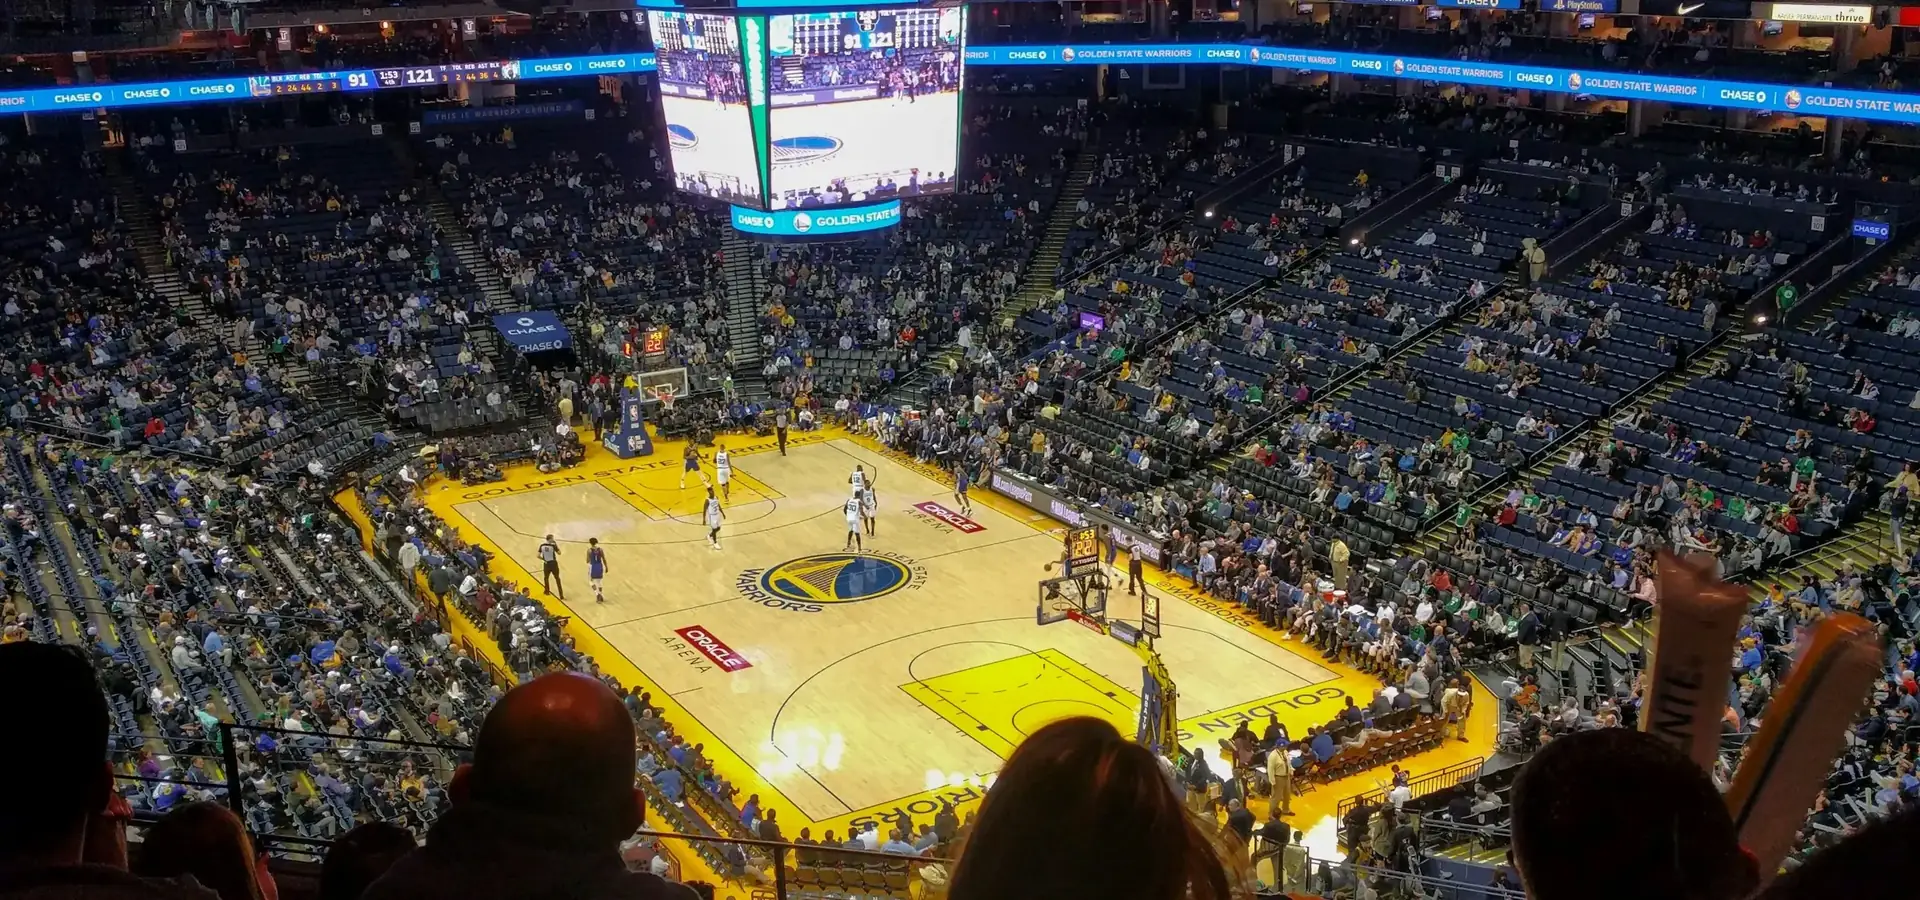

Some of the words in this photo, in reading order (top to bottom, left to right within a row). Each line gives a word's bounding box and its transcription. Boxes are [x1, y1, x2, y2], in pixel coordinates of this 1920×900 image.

[1567, 1, 1603, 10] PlayStation
[1835, 11, 1864, 22] thrive
[844, 34, 862, 49] 91
[868, 32, 893, 48] 121
[1078, 50, 1115, 58] GOLDEN
[1116, 50, 1143, 58] STATE
[1144, 50, 1192, 58] WARRIORS
[1207, 50, 1234, 58] CHASE
[1261, 52, 1286, 61] GOLDEN
[1287, 54, 1307, 63] STATE
[1351, 60, 1374, 69] CHASE
[534, 64, 564, 73] CHASE
[588, 61, 618, 69] CHASE
[640, 58, 656, 66] CHA
[1406, 63, 1437, 74] GOLDEN
[1438, 66, 1461, 76] STATE
[1462, 68, 1503, 79] WARRIORS
[1516, 73, 1544, 83] CHASE
[286, 74, 296, 82] AST
[348, 73, 368, 87] 91
[380, 70, 398, 79] 1:53
[406, 69, 435, 83] 121
[54, 93, 91, 103] CHASE
[124, 89, 160, 99] CHASE
[190, 85, 224, 95] CHASE
[1585, 78, 1622, 90] GOLDEN
[1624, 80, 1651, 92] STATE
[1720, 89, 1755, 101] CHASE
[1805, 96, 1853, 108] GOLDEN
[1855, 99, 1891, 111] STATE
[435, 112, 456, 121] THIS
[461, 111, 469, 120] IS
[738, 215, 764, 225] CHASE
[816, 215, 864, 227] GOLDEN
[866, 210, 890, 223] STATE
[1812, 222, 1823, 230] 101
[1853, 224, 1880, 235] CHASE
[507, 325, 557, 336] CHASE
[518, 341, 553, 353] CHASE
[647, 339, 661, 351] 22
[462, 474, 585, 500] GOLDEN
[593, 459, 678, 480] STATE
[848, 503, 857, 512] 30
[903, 508, 954, 535] ARENA
[924, 504, 978, 531] ORACLE
[1079, 556, 1097, 565] TISSOT
[912, 565, 929, 591] STATE
[736, 568, 824, 613] WARRIORS
[1156, 581, 1255, 627] @WARRIORS
[660, 636, 712, 674] ARENA
[686, 630, 742, 668] ORACLE
[1198, 687, 1345, 733] GOLDEN
